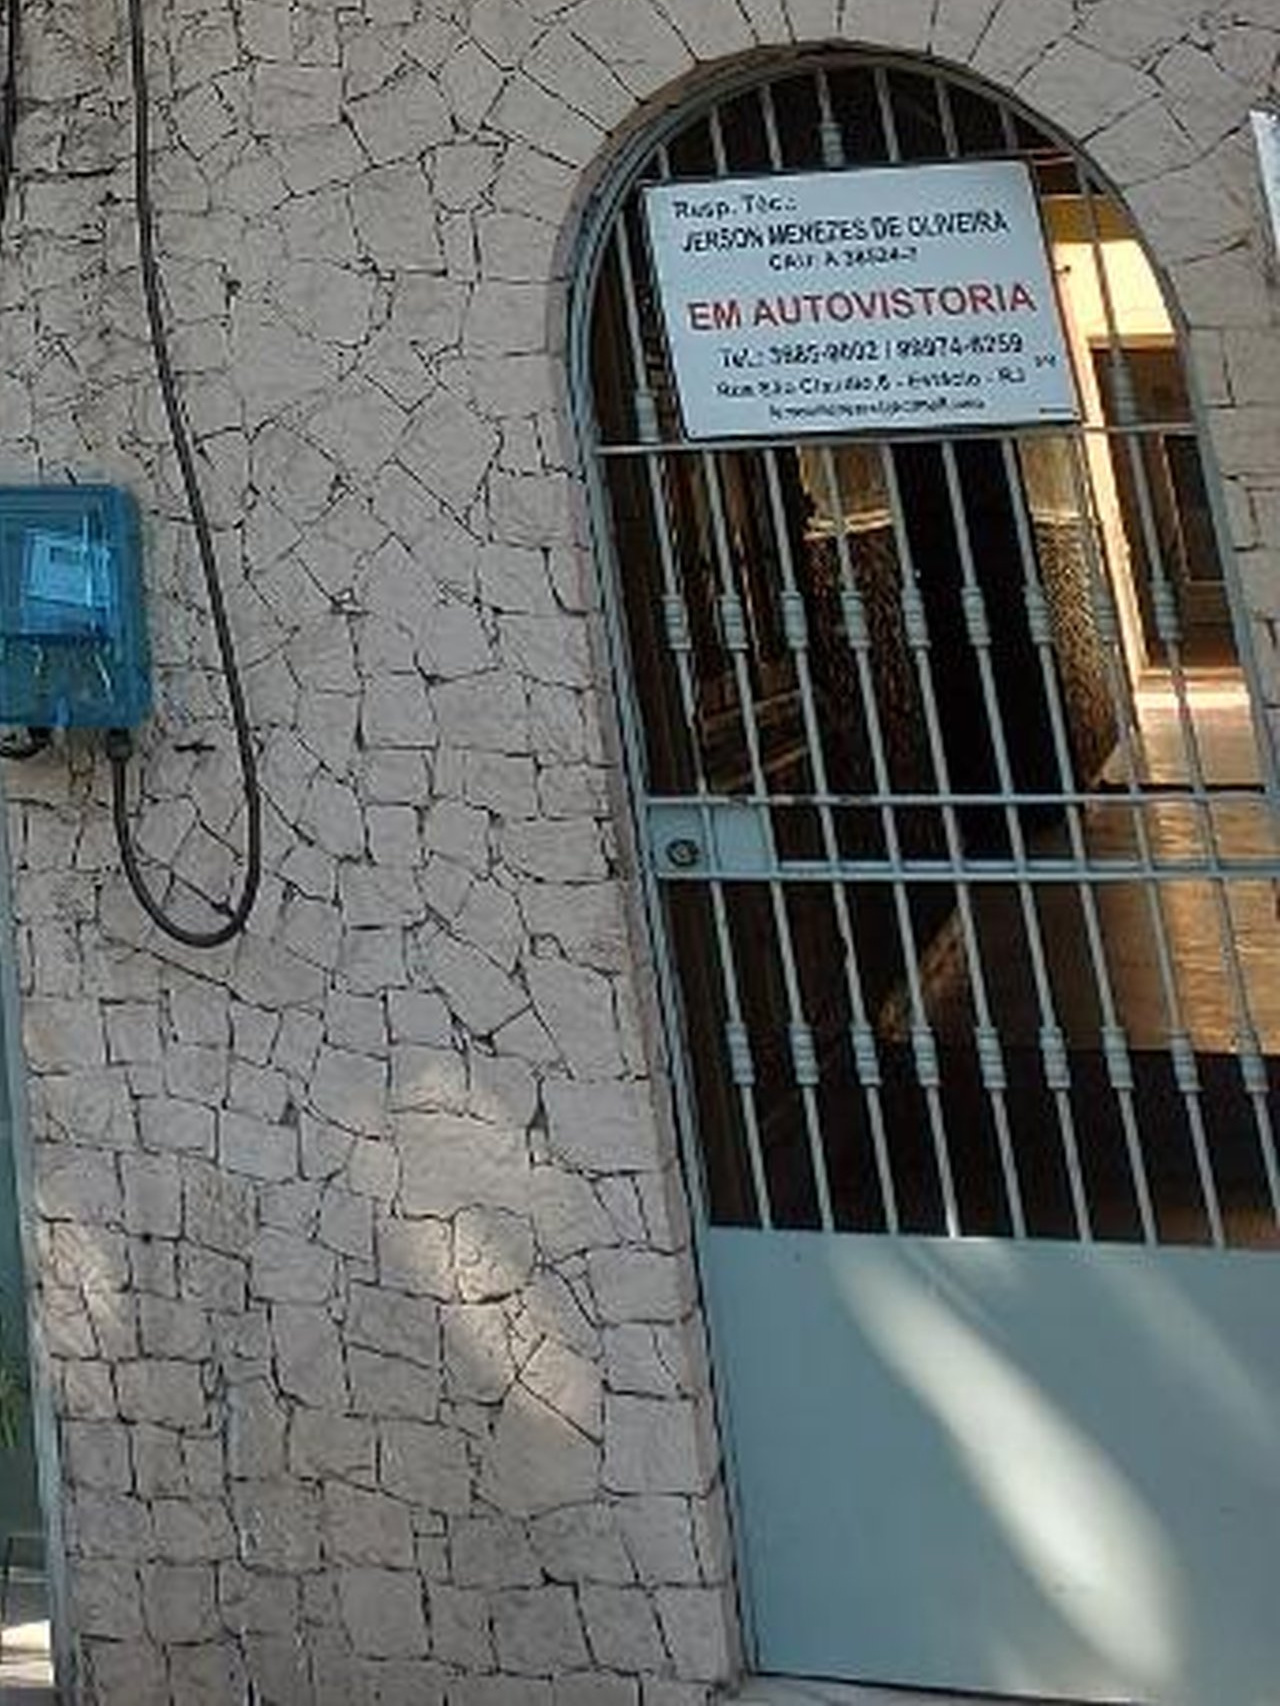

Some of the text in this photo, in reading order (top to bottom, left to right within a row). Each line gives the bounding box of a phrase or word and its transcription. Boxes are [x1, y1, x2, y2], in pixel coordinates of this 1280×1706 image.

[683, 209, 1010, 252] JERSON MENEZES DE OLIVEIRA
[688, 284, 1036, 330] EM AUTOVISTORIA
